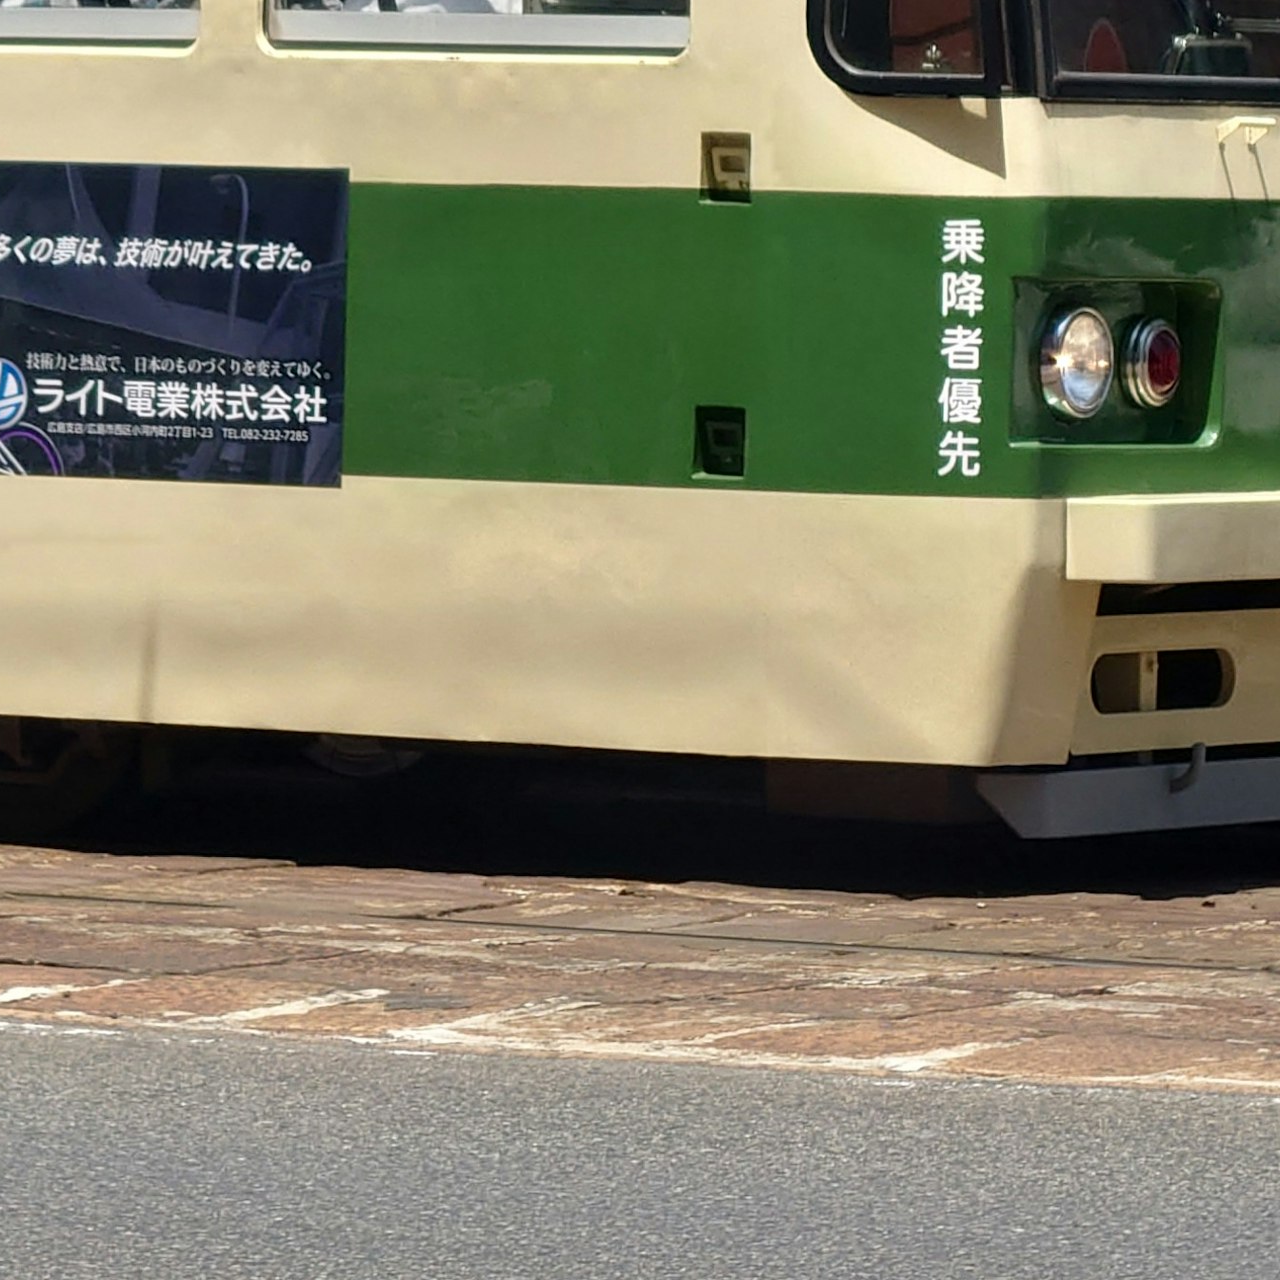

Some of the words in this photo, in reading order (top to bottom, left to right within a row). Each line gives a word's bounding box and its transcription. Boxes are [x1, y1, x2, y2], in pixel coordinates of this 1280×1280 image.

[32, 377, 329, 425] ライト電業株式会社
[937, 218, 985, 477] 乗降者優先
